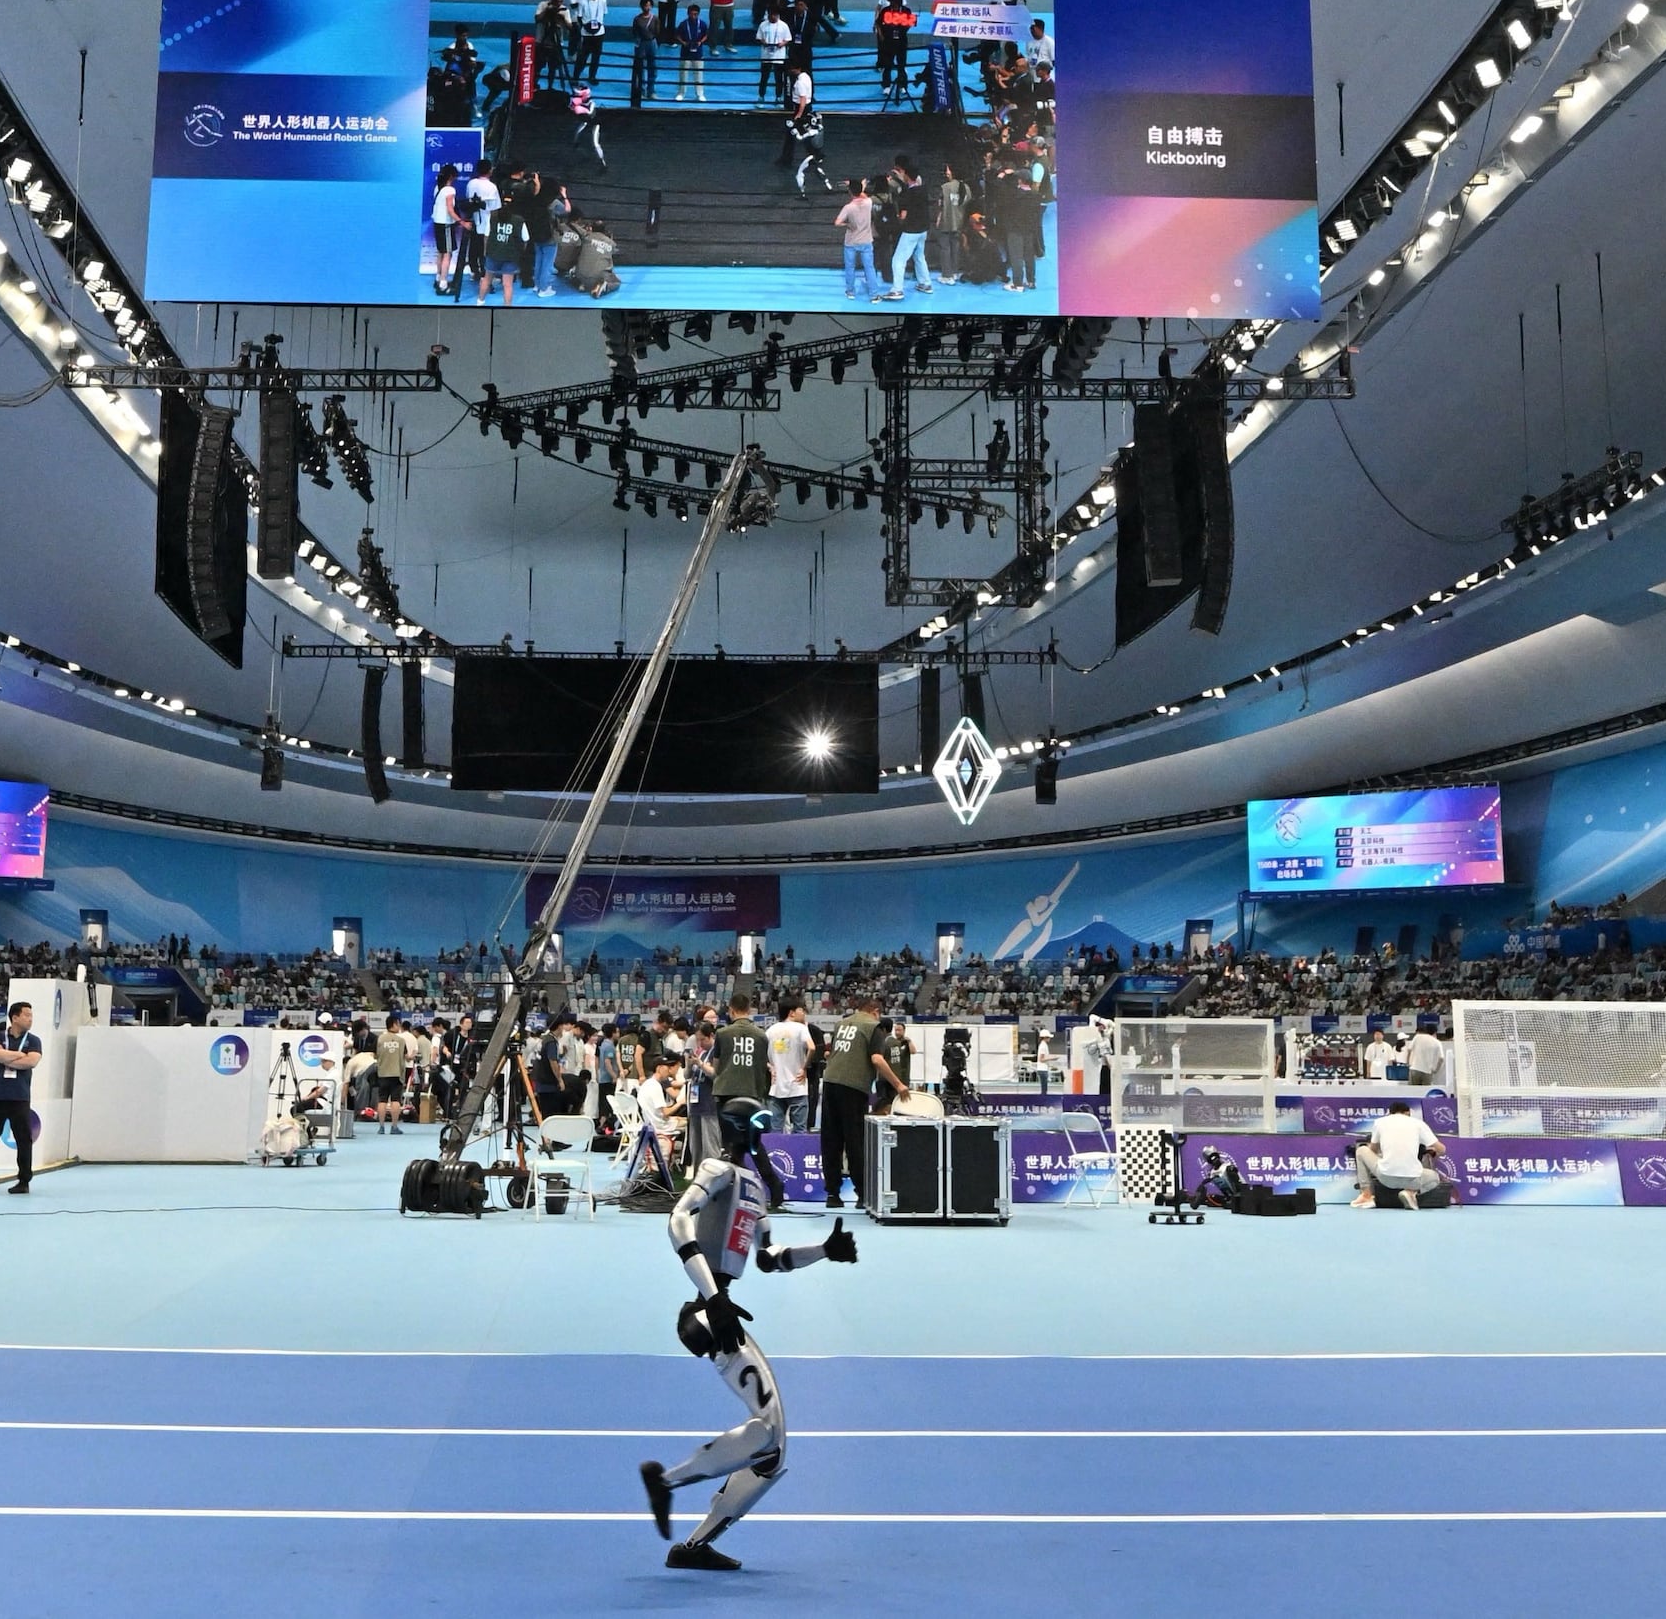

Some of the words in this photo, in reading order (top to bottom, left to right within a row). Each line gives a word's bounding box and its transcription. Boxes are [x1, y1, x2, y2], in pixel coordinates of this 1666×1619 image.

[940, 6, 992, 17] 北航致远队
[522, 43, 533, 101] UNITREE
[933, 49, 948, 106] UNITREE
[242, 114, 390, 131] 世界人形机器人运动会
[233, 131, 251, 141] The
[252, 132, 282, 142] World
[283, 132, 332, 142] Humanoid
[333, 133, 363, 143] Robot
[364, 134, 398, 143] Games
[1148, 125, 1224, 146] 自由搏击
[1146, 150, 1227, 168] Kickboxing
[496, 222, 513, 235] HB
[612, 892, 737, 905] 世界人形机器人运动会
[837, 1024, 858, 1040] HB
[621, 1044, 635, 1055] HB
[733, 1037, 755, 1053] HB
[835, 1040, 851, 1053] 090
[733, 1053, 754, 1067] 018
[1465, 1158, 1605, 1174] 世界人形机器人运动会
[803, 1172, 819, 1180] The
[1025, 1172, 1041, 1181] The
[1042, 1172, 1067, 1181] World
[1248, 1173, 1264, 1182] The
[1265, 1174, 1290, 1183] World
[1291, 1174, 1332, 1183] Humanoid
[1466, 1175, 1484, 1184] The
[1485, 1175, 1508, 1184] World
[739, 1365, 773, 1409] 2
